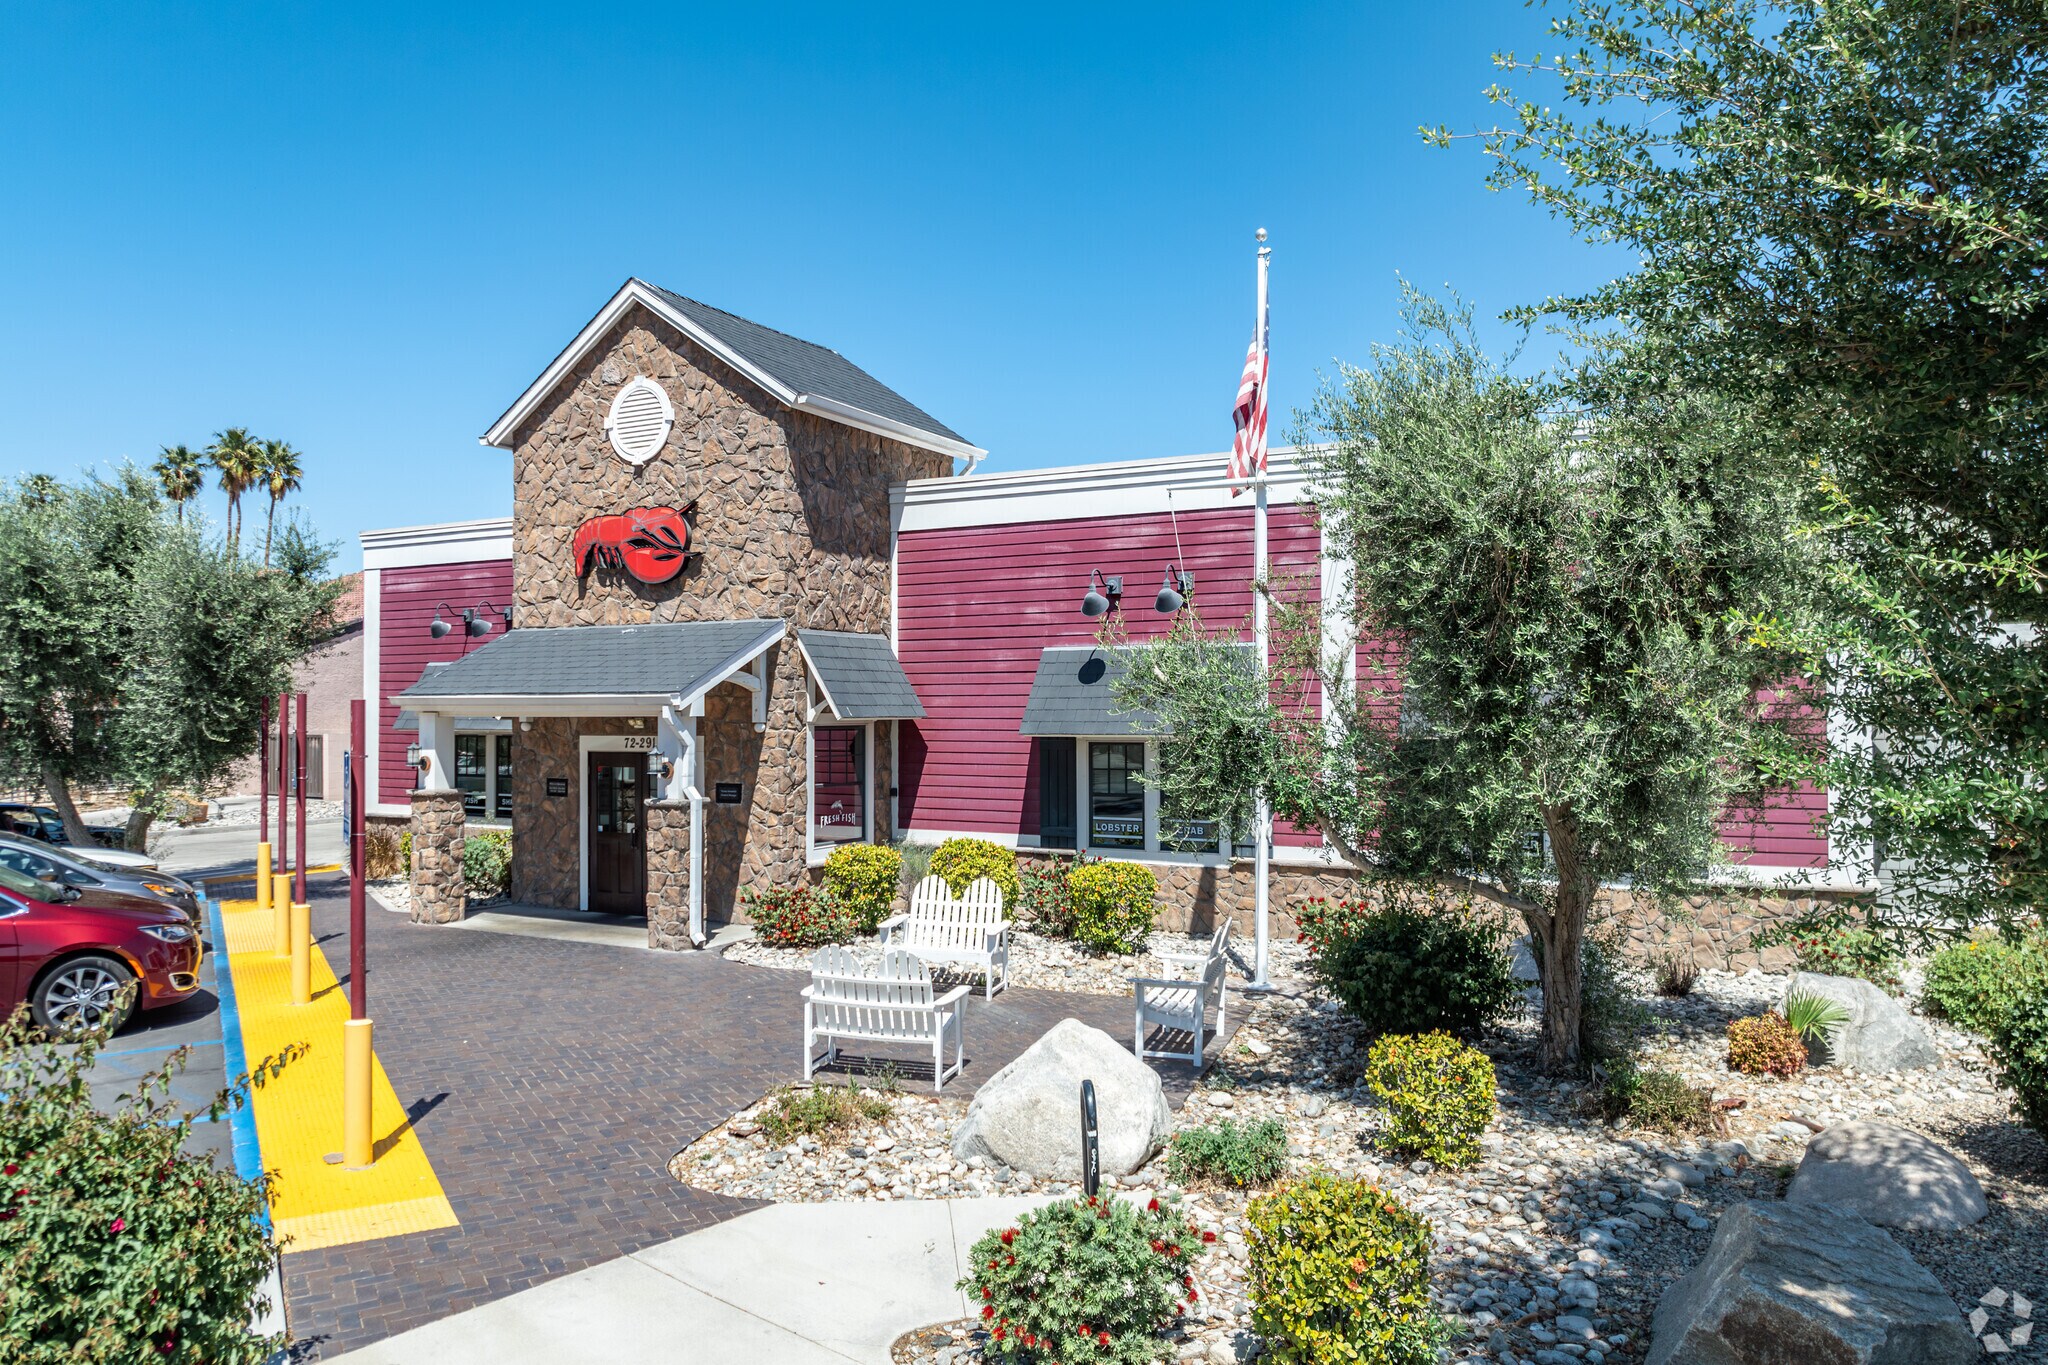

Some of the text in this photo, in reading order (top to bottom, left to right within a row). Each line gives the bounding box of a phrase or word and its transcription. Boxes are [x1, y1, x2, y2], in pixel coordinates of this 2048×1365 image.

[624, 737, 656, 749] 72-291
[820, 812, 856, 829] FRESH FISH
[1095, 822, 1140, 833] LOBSTER
